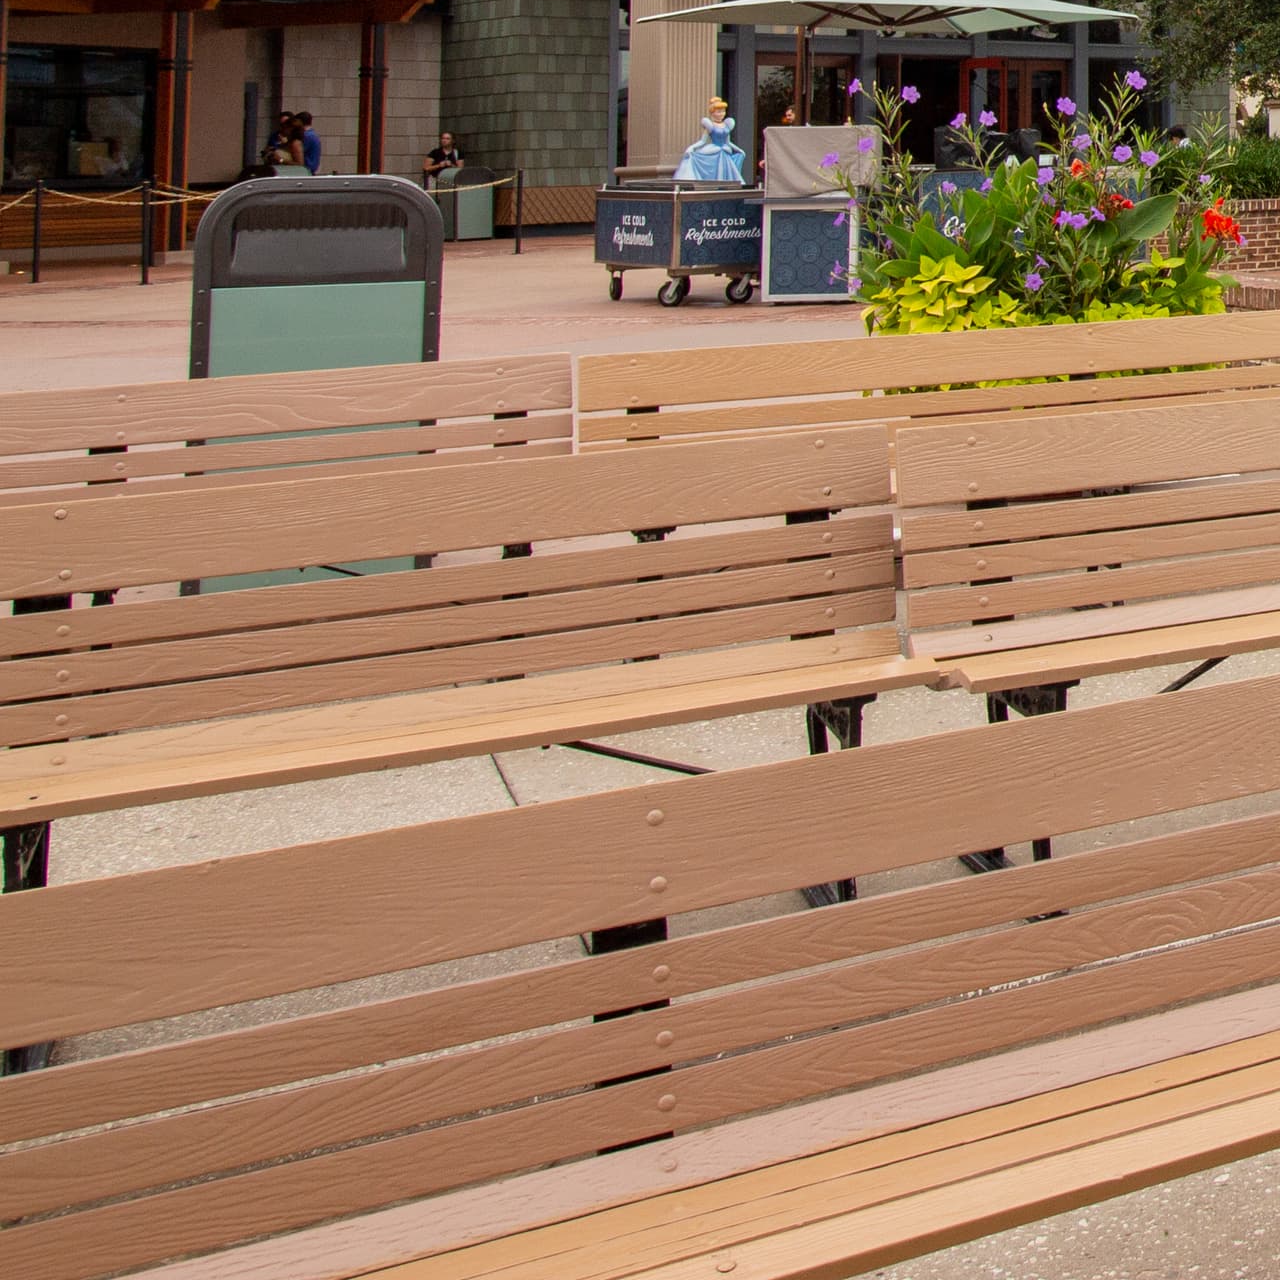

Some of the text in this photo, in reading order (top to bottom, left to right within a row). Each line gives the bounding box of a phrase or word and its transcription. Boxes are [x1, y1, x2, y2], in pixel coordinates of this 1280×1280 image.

[622, 215, 646, 226] ICE COLD
[702, 217, 746, 227] ICE COLD
[612, 226, 654, 252] Refreshments
[685, 225, 761, 246] Refreshments
